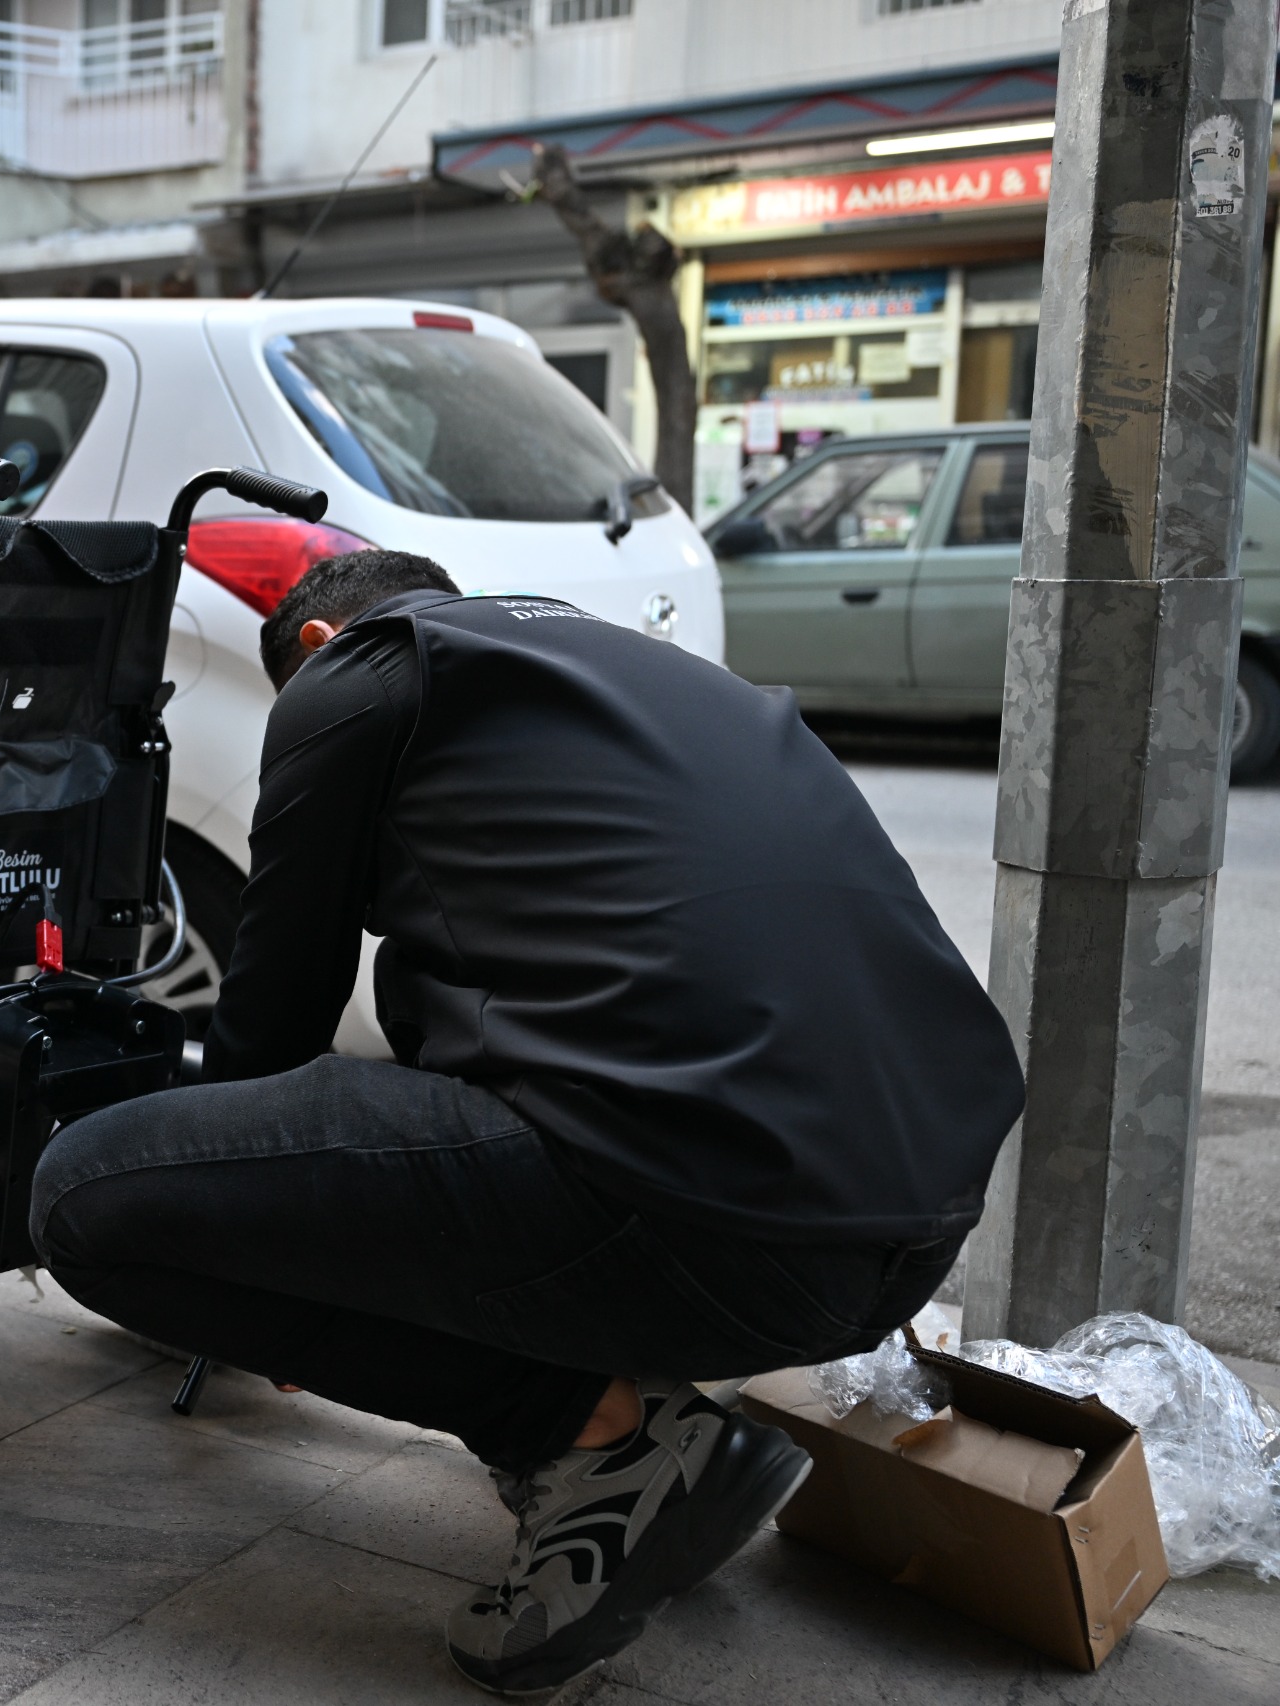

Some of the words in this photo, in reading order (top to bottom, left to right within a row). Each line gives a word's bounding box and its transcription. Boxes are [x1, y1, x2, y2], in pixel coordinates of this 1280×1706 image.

[1228, 146, 1240, 158] 20
[845, 169, 990, 211] AMBALAJ
[1002, 167, 1025, 194] &
